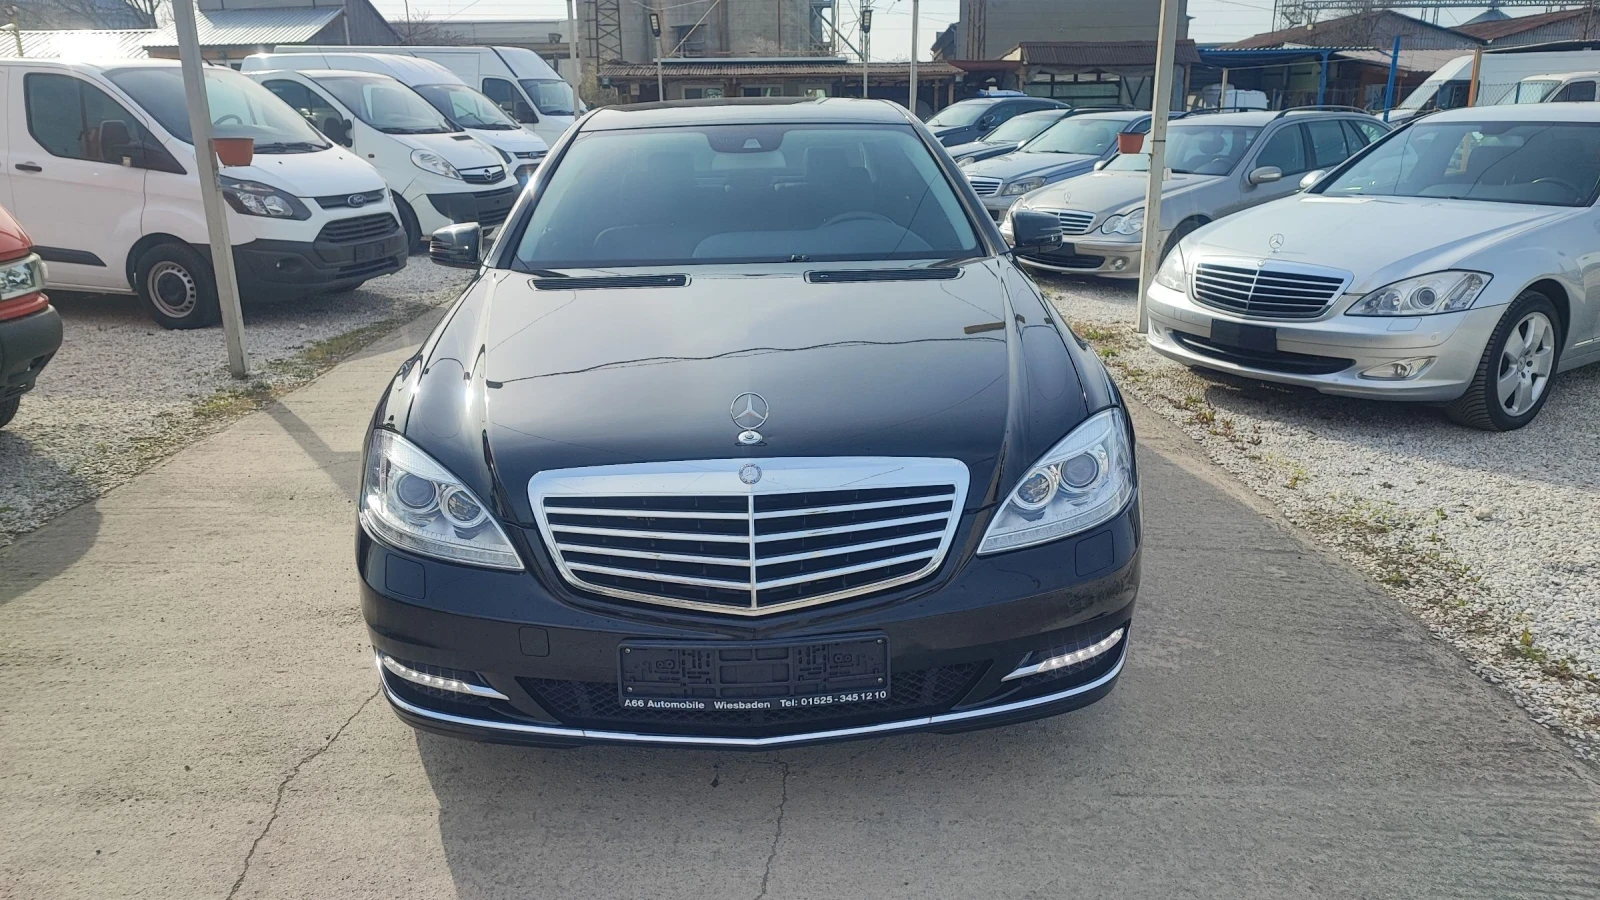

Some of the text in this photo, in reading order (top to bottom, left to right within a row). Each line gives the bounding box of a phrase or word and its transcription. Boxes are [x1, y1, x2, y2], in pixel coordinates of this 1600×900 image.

[624, 699, 645, 708] A66
[647, 699, 705, 709] Automobile
[714, 700, 771, 709] Wiesbaden
[780, 699, 798, 707] Tel:
